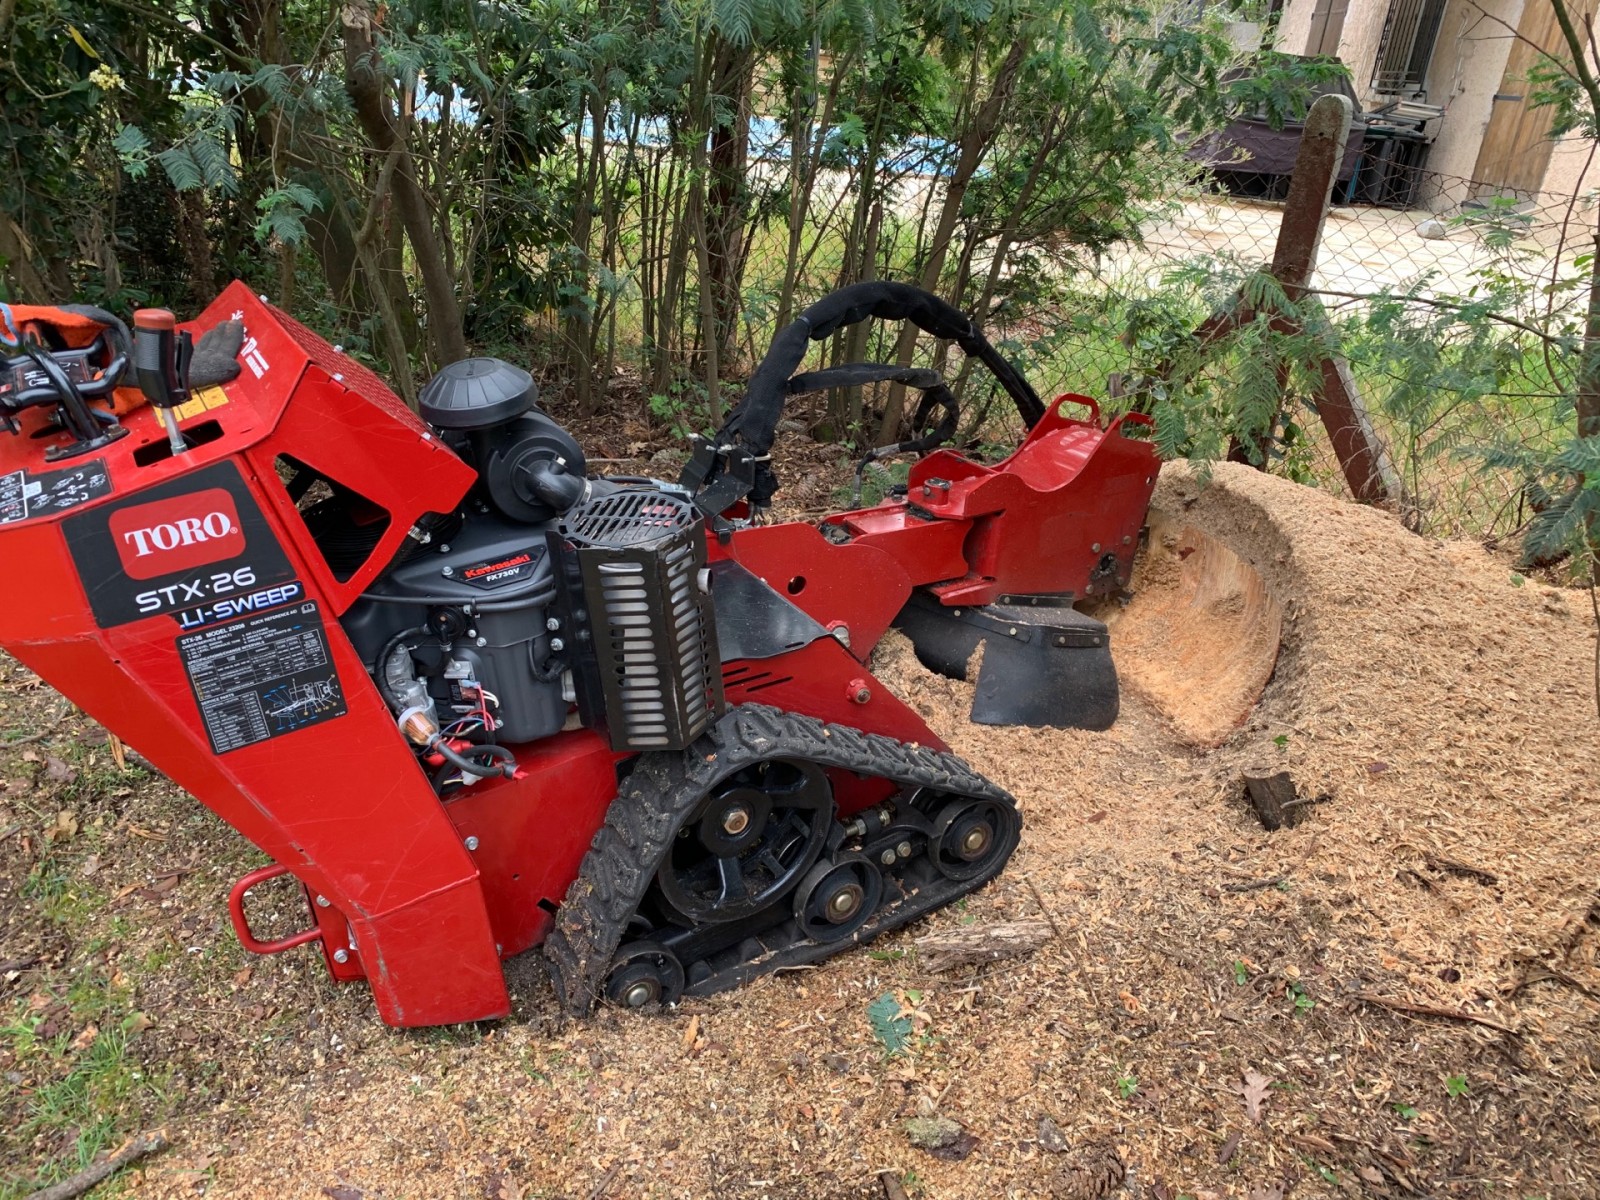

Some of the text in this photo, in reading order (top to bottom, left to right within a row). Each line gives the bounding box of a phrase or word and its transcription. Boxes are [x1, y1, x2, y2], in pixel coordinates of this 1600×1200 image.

[464, 553, 531, 578] Kawasaki
[486, 567, 520, 582] FX730V
[180, 584, 299, 629] LI-SWEEP
[263, 611, 289, 621] REFERENCE
[205, 627, 228, 638] MODEL
